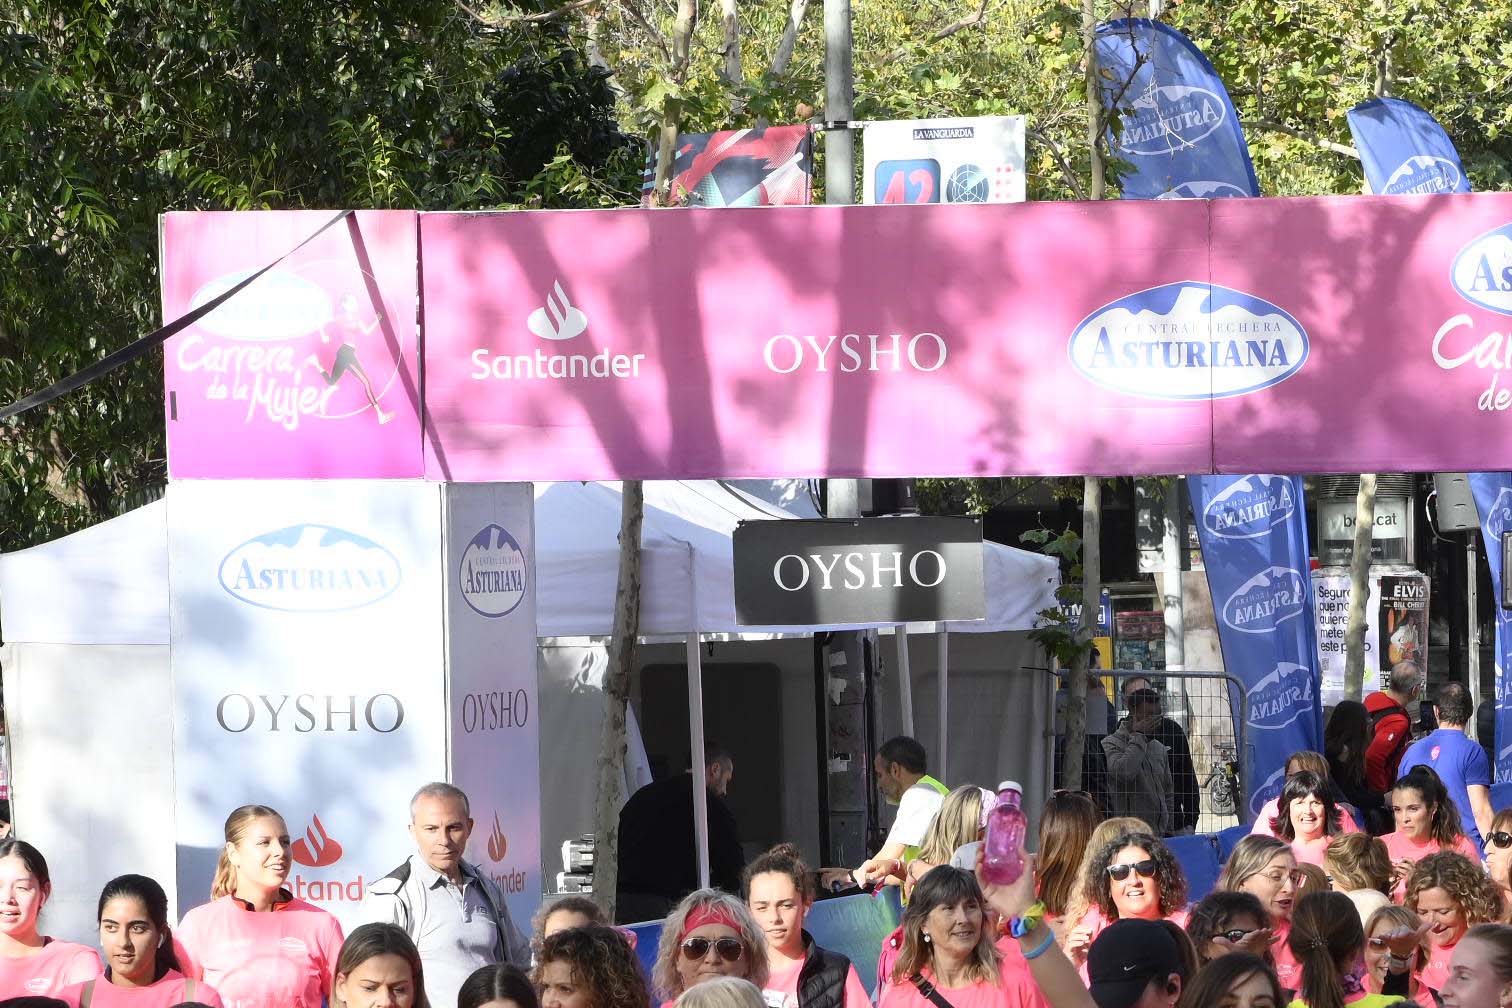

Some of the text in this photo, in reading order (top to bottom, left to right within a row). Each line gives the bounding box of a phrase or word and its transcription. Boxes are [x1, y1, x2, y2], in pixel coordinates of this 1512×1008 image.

[913, 128, 973, 139] LA VANGUARDIA
[471, 347, 645, 380] Santander
[763, 332, 947, 374] OYSHO
[1088, 325, 1291, 370] ASTURIANA
[206, 376, 228, 401] de
[245, 364, 339, 431] Mujer
[1477, 372, 1512, 412] de
[233, 558, 389, 592] ASTURIANA
[464, 553, 524, 596] ASTURIANA
[773, 549, 947, 591] OYSHO
[1320, 603, 1335, 614] que
[1393, 585, 1425, 598] ELVIS
[1320, 642, 1340, 652] este
[216, 692, 405, 734] OYSHO
[462, 688, 529, 734] OYSHO
